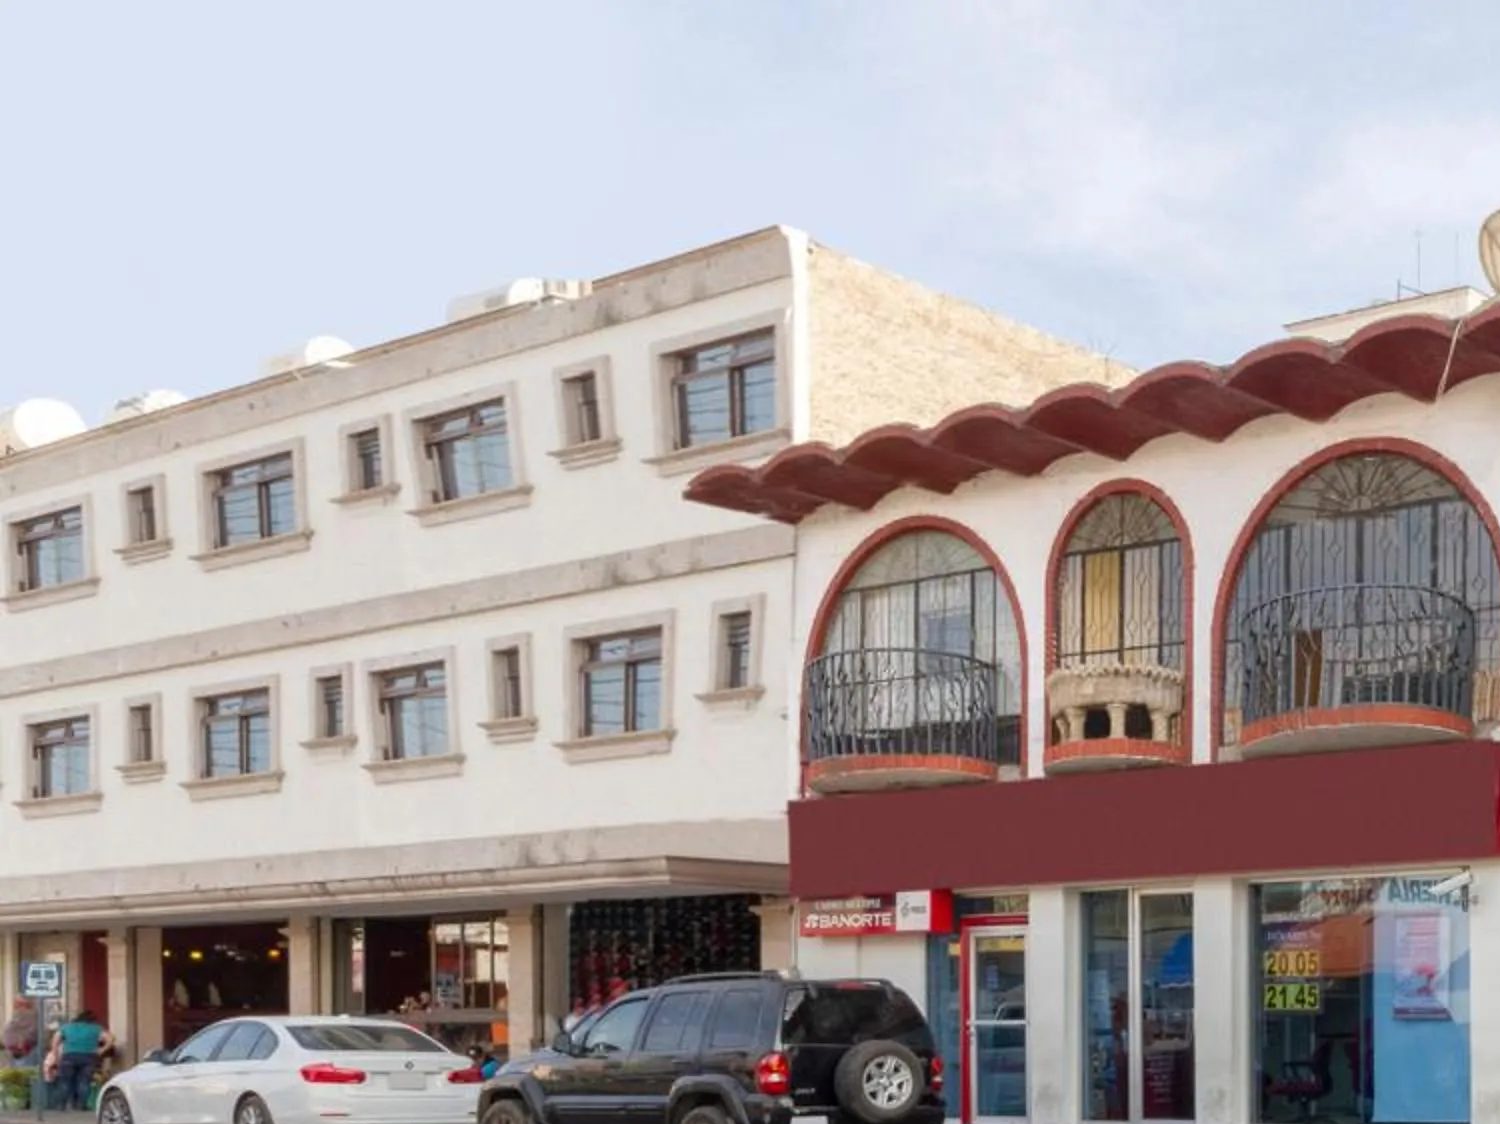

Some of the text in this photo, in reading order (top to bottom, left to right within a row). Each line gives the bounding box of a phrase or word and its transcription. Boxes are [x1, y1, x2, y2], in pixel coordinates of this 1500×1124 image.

[819, 912, 892, 929] BANORTE
[1267, 952, 1318, 976] 20.05
[1267, 985, 1317, 1009] 21.45
